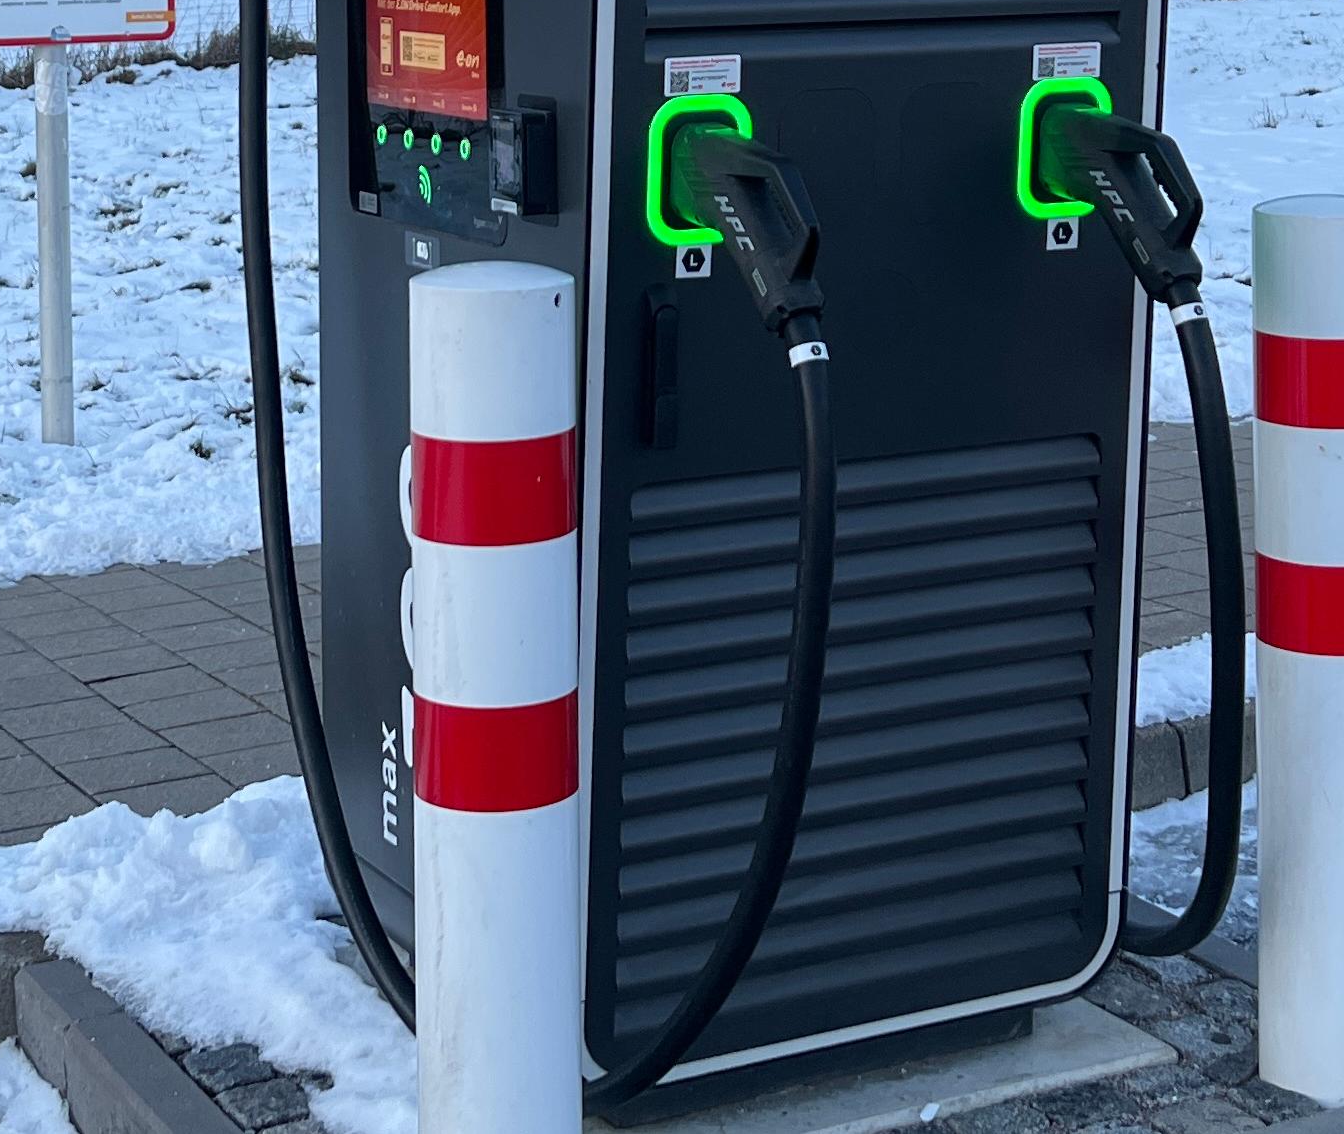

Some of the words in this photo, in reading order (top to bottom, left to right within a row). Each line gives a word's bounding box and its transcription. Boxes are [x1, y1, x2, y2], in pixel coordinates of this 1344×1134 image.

[713, 195, 756, 251] HPC
[1089, 170, 1135, 222] HPC
[381, 720, 398, 846] max
